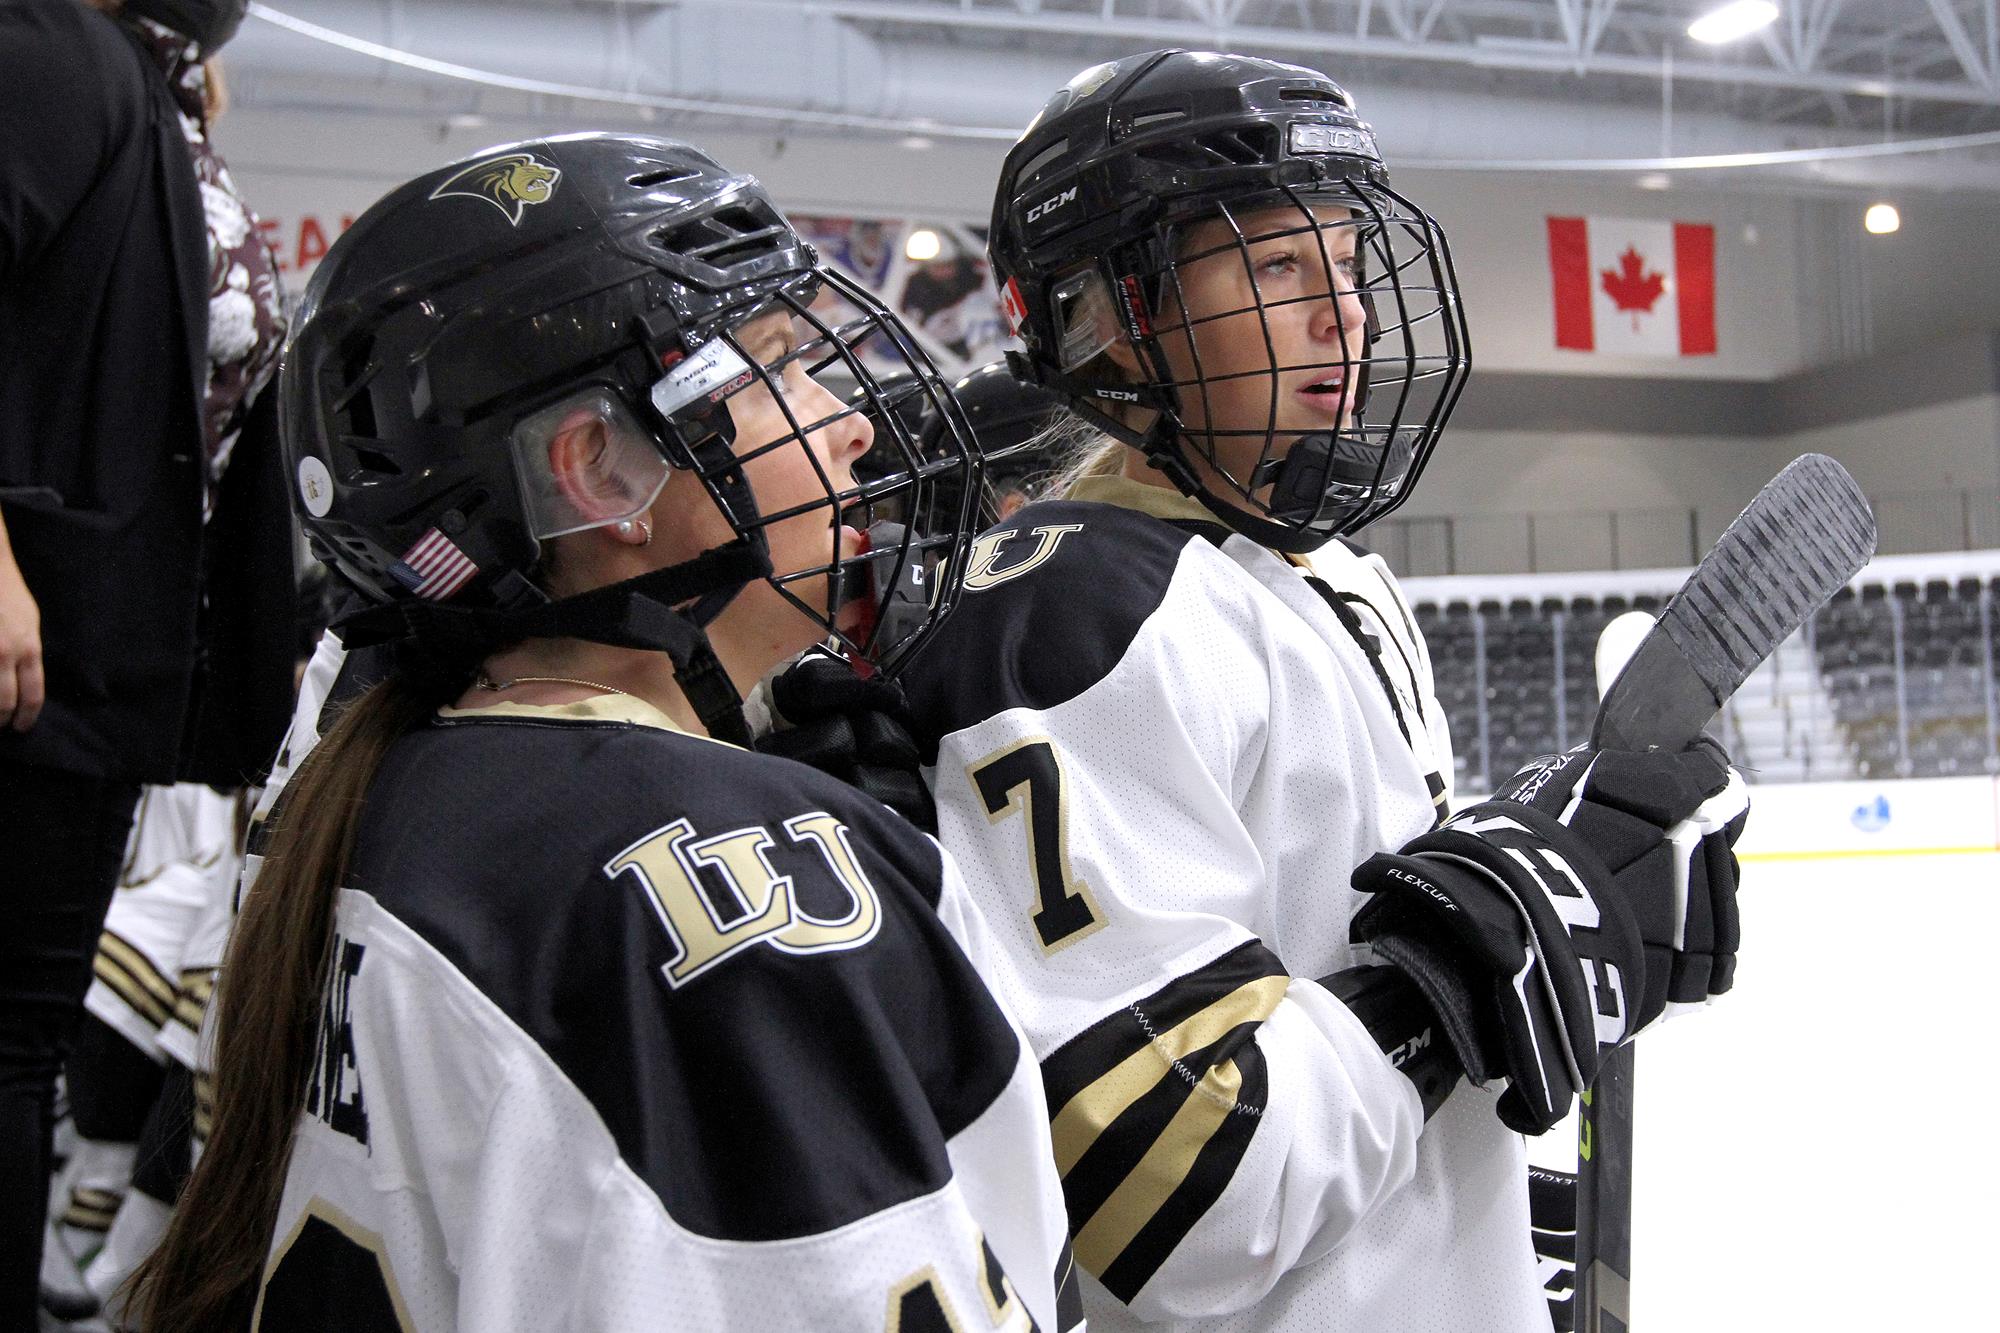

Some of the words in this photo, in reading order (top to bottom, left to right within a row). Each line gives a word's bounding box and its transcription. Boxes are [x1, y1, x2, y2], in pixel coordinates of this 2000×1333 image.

[1026, 185, 1078, 223] CCM
[1096, 389, 1138, 402] CCM
[1518, 754, 1576, 806] TACKS
[964, 734, 1111, 959] 7
[602, 811, 883, 991] LU
[1386, 868, 1460, 912] FLEXCUFF
[1385, 1026, 1431, 1069] CM
